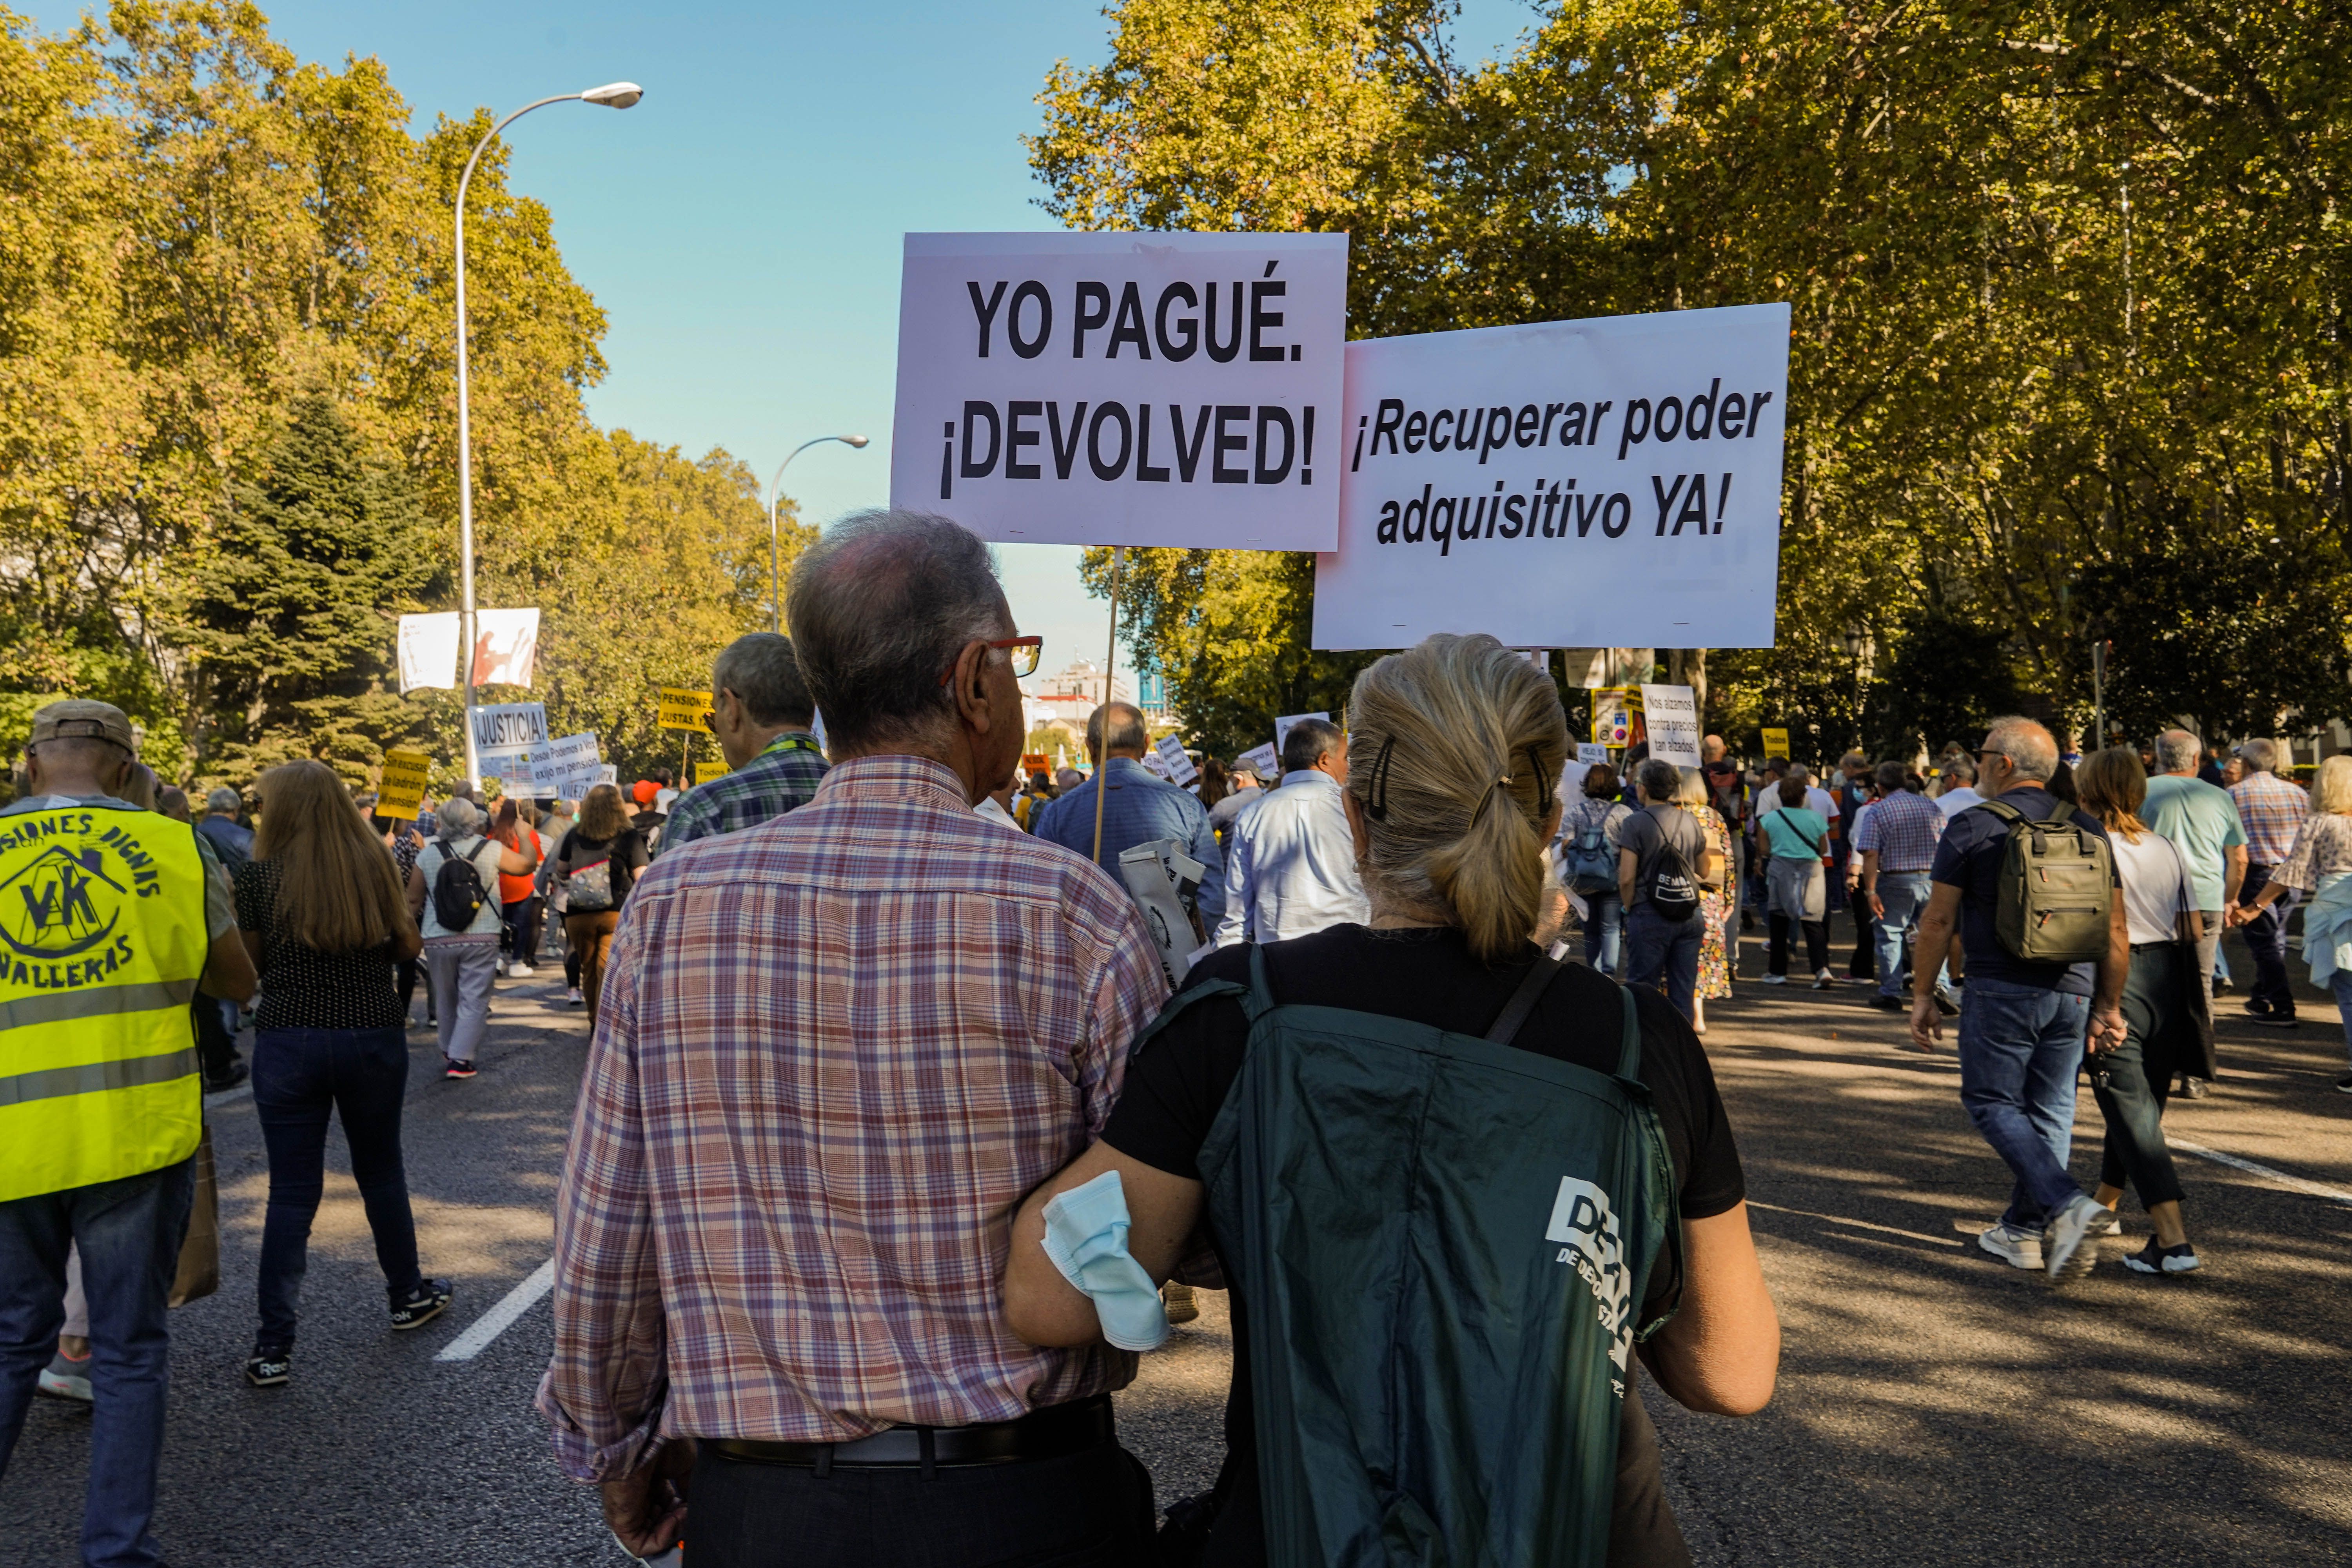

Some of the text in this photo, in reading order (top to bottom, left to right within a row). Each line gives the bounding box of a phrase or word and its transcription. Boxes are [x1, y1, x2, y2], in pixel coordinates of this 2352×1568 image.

[967, 261, 1301, 362] YO PAGUÉ.
[1351, 378, 1772, 472] ¡Recuperar poder
[941, 401, 1314, 499] ¡DEVOLVED!
[1377, 474, 1732, 556] adquisitivo YA!
[1664, 696, 1692, 711] alzamos
[474, 711, 545, 744] ¡JUSTICIA!
[1649, 717, 1697, 734] contra precios
[530, 751, 549, 763] Desde
[550, 744, 578, 758] Podemos
[583, 740, 595, 750] Vox
[1655, 737, 1696, 753] tan alzados!
[386, 755, 427, 773] Sin excusas
[535, 766, 554, 780] exijo
[555, 763, 566, 776] mi
[382, 774, 391, 786] de
[0, 814, 160, 898] SIONES DIGNAS
[19, 866, 96, 929] VK
[1555, 1247, 1581, 1267] DE
